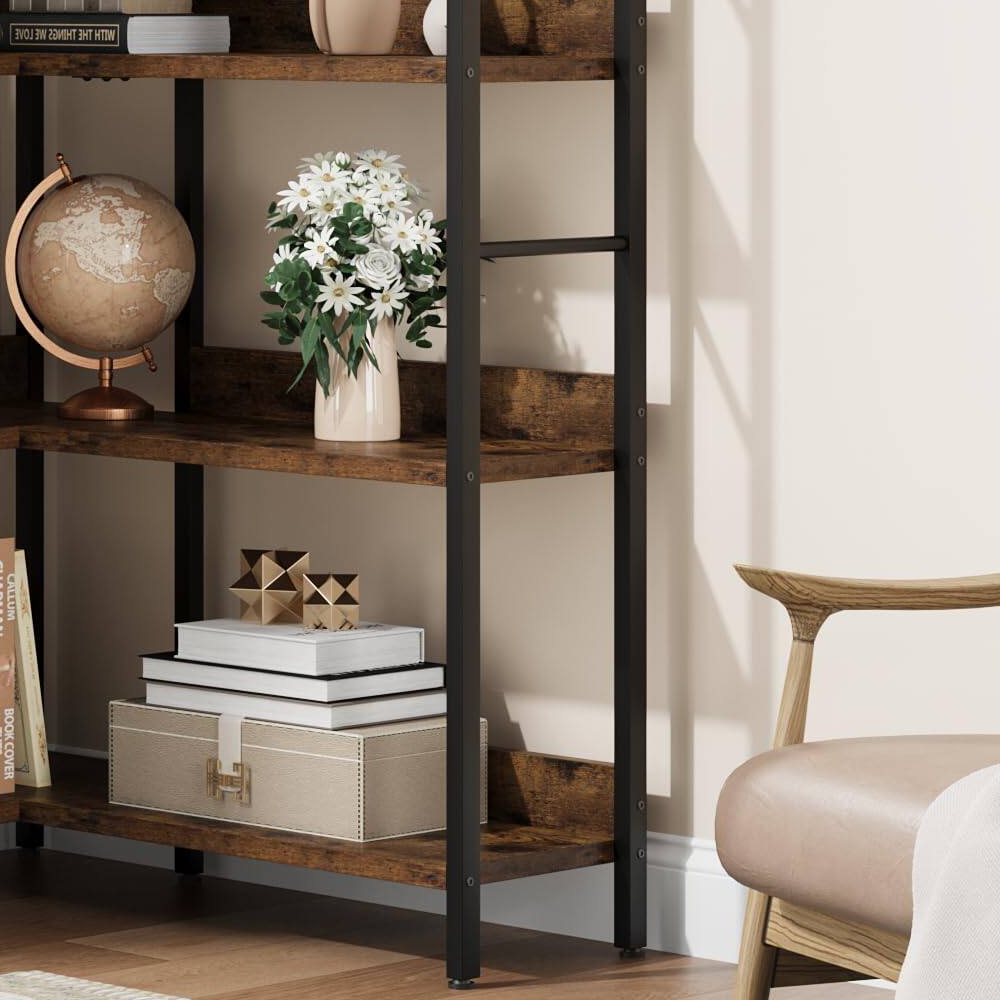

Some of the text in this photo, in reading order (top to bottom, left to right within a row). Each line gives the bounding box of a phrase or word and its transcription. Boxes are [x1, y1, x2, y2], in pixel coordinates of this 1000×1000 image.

[6, 572, 16, 621] CALLUM
[3, 708, 15, 780] BOOK COVER
